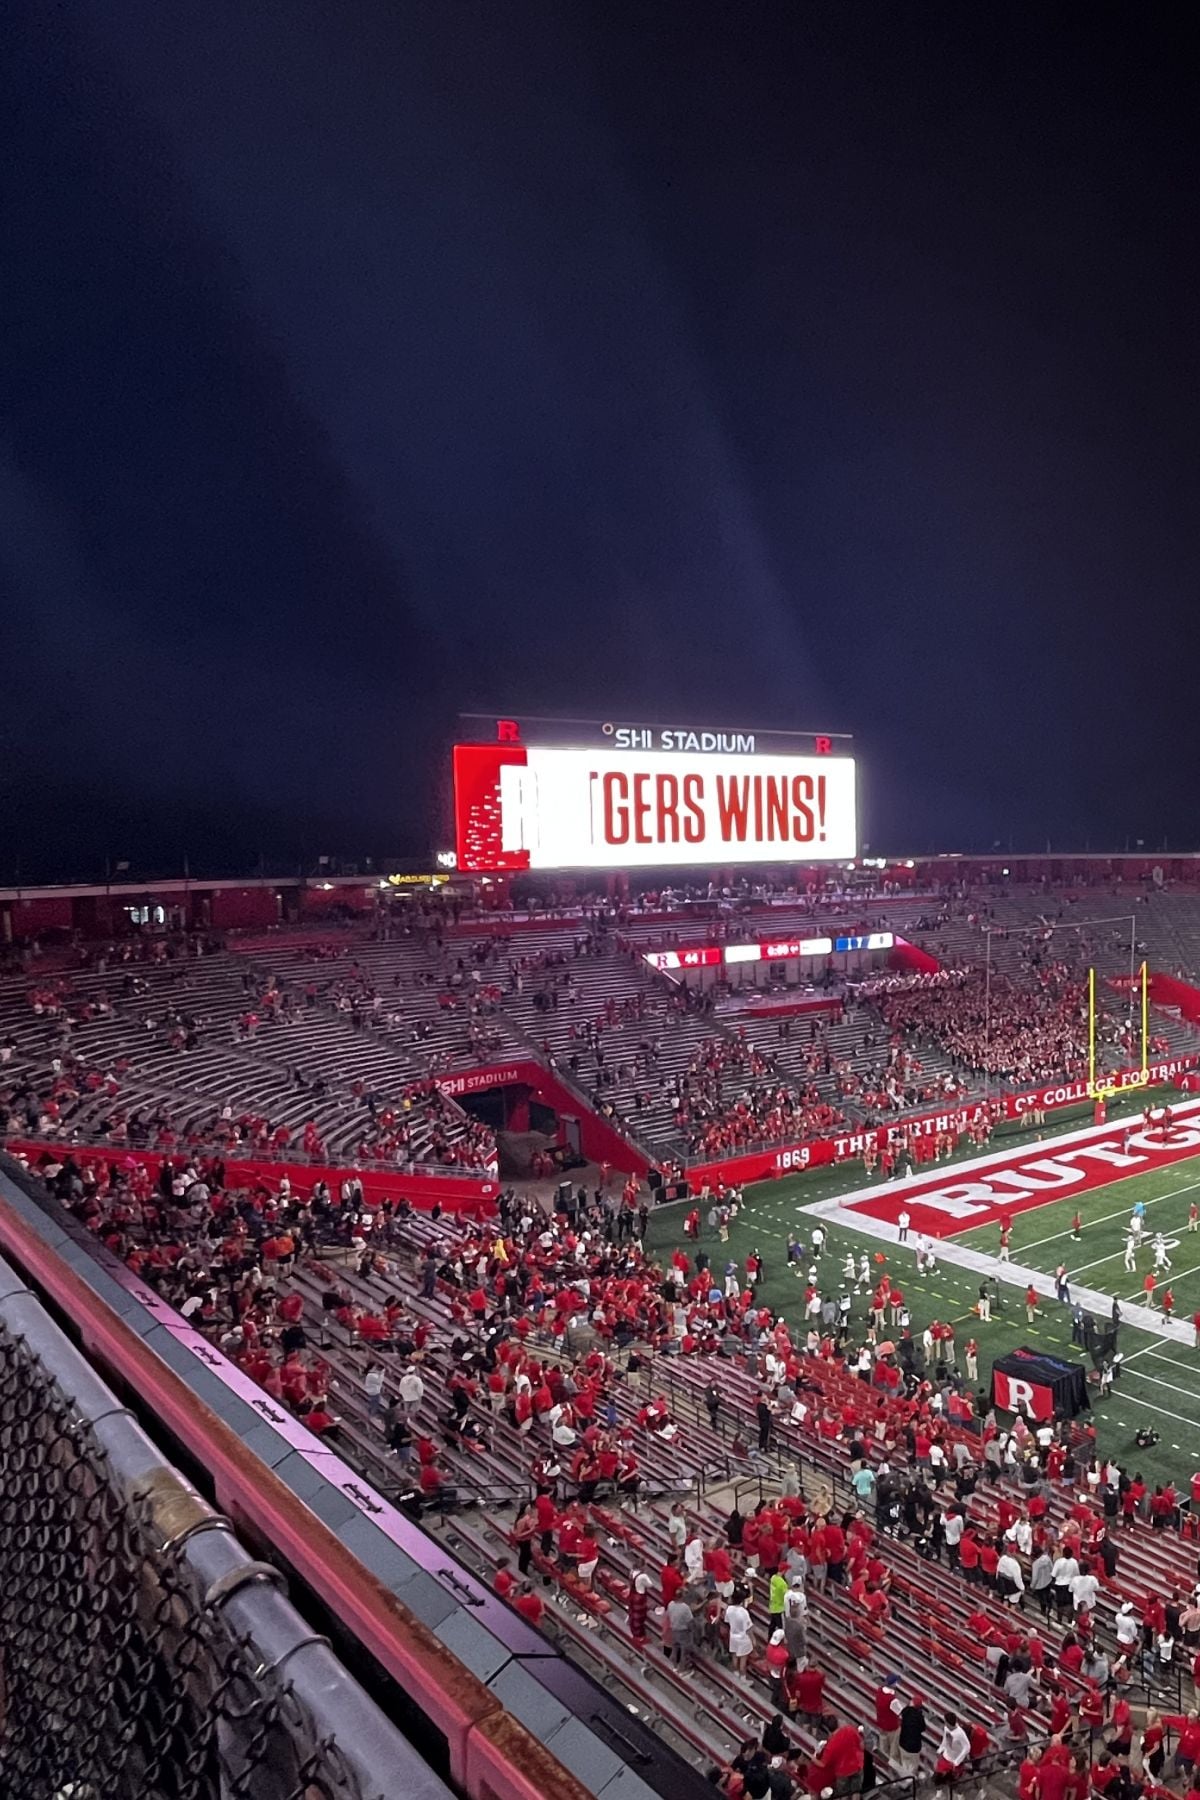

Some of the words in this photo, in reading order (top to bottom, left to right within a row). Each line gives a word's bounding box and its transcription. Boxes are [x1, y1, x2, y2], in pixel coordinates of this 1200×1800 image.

[497, 720, 520, 741] R
[615, 728, 653, 750] SHI
[661, 730, 756, 754] STADIUM
[815, 736, 832, 755] R
[590, 771, 705, 846] GERS
[715, 773, 828, 843] WINS!
[441, 1079, 465, 1094] SHI
[467, 1070, 518, 1088] STADIUM
[776, 1147, 810, 1169] 1869
[1043, 1077, 1115, 1106] COLLEGE
[1007, 1376, 1037, 1420] R
